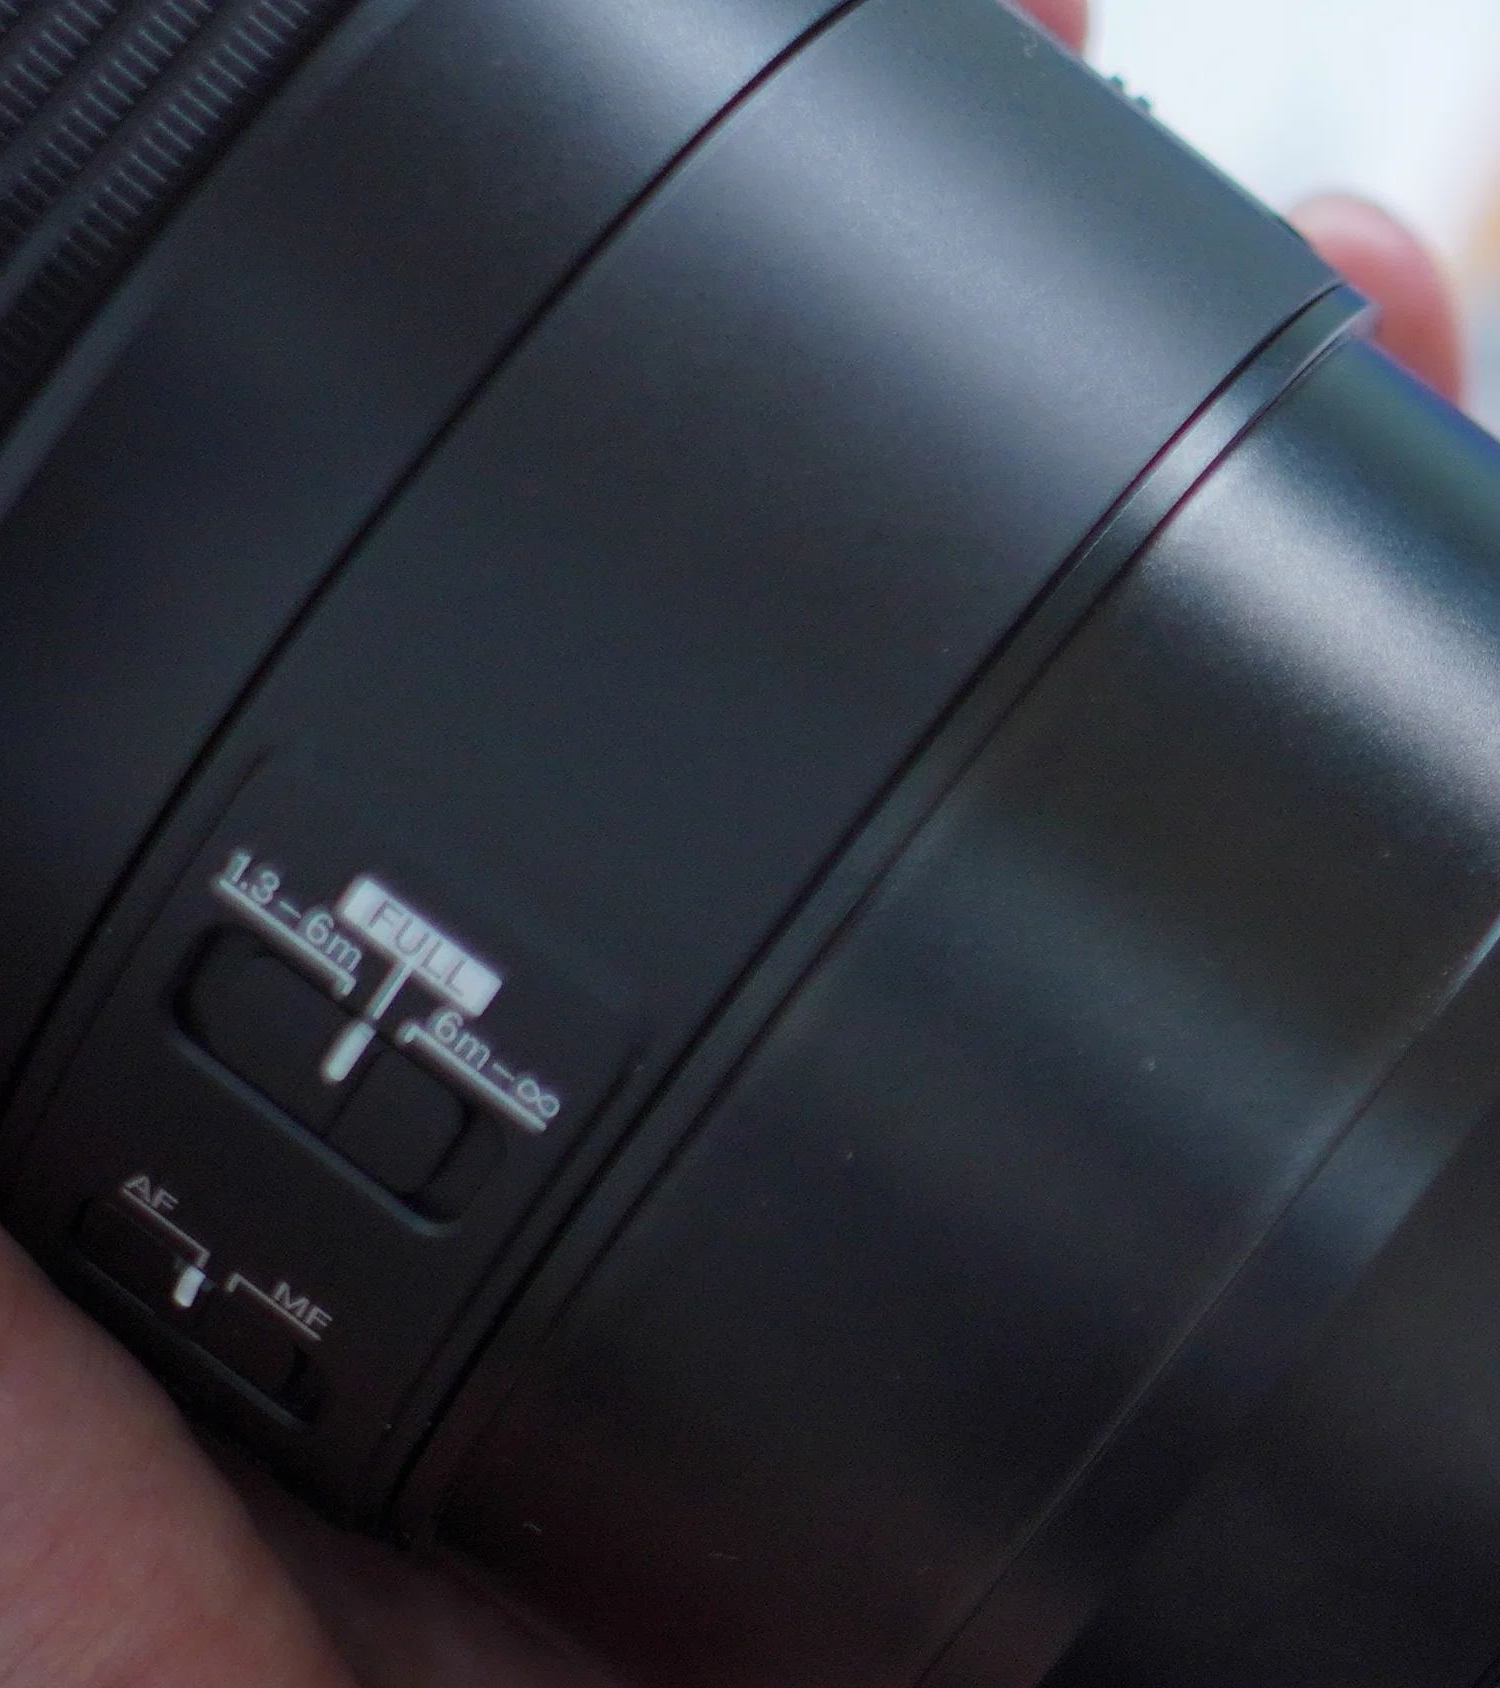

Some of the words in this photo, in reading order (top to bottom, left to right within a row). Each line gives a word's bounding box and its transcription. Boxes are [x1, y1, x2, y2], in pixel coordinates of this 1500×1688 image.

[370, 900, 471, 997] FULL
[123, 1175, 179, 1212] AF
[272, 1281, 332, 1330] MF
